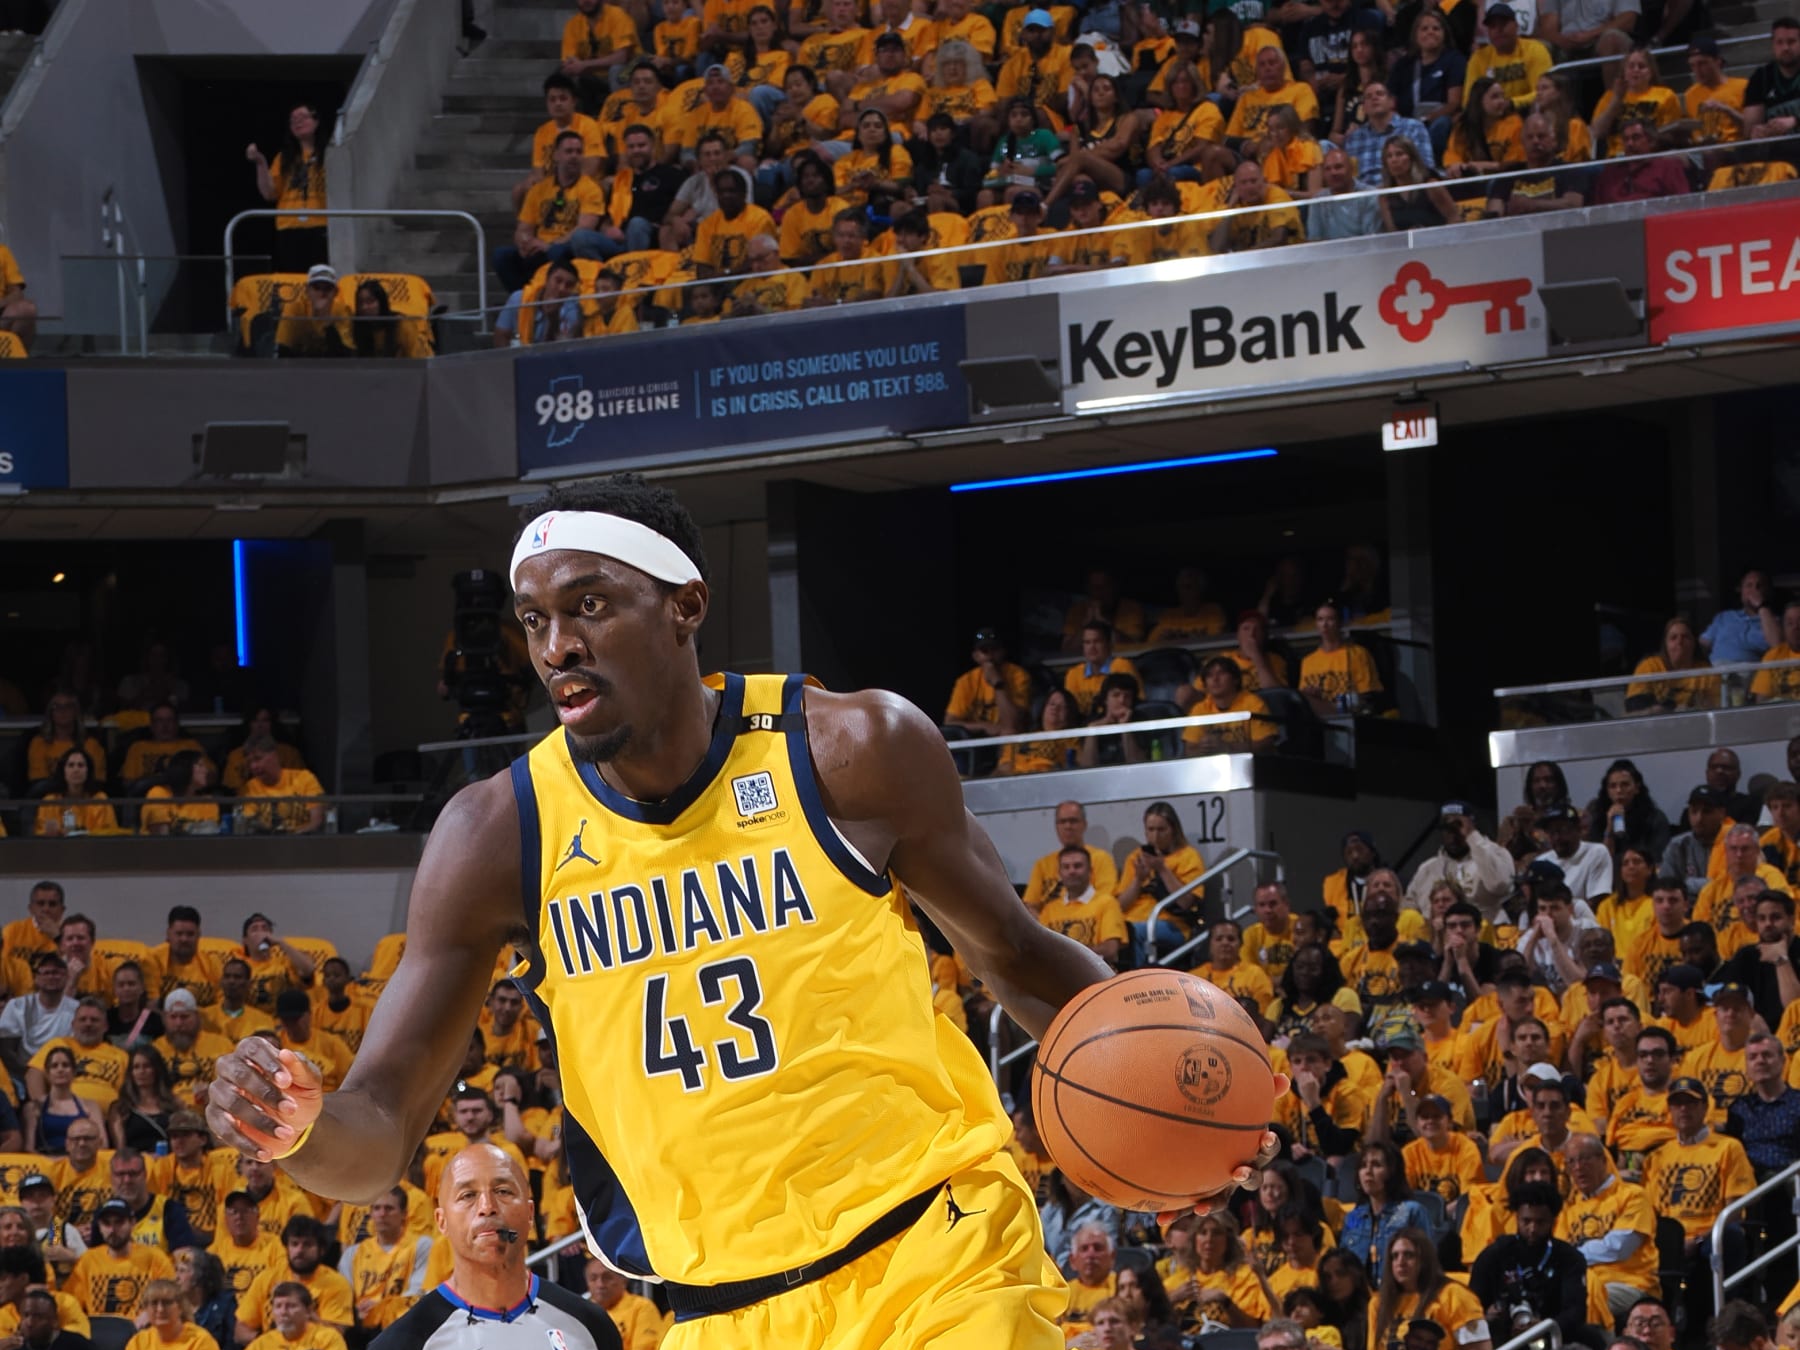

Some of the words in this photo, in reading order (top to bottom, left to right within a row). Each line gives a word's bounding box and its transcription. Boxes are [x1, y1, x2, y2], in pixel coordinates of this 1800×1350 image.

[1068, 292, 1365, 387] KeyBank
[710, 368, 725, 387] IF
[727, 366, 758, 385] YOU
[761, 363, 784, 381] OR
[787, 351, 862, 379] SOMEONE
[864, 348, 897, 369] YOU
[900, 342, 940, 365] LOVE
[535, 390, 594, 426] 988
[599, 393, 680, 417] LIFELINE
[711, 398, 727, 417] IS
[730, 395, 746, 415] IN
[749, 388, 804, 413] CRISIS,
[805, 383, 845, 406] CALL
[847, 380, 870, 401] OR
[872, 375, 910, 398] TEXT
[914, 372, 949, 394] 988.
[1392, 411, 1426, 440] EXIT
[750, 714, 773, 730] 30
[736, 810, 786, 829] spokenote
[1197, 796, 1226, 844] 12
[548, 847, 817, 978] INDIANA
[642, 954, 779, 1093] 43
